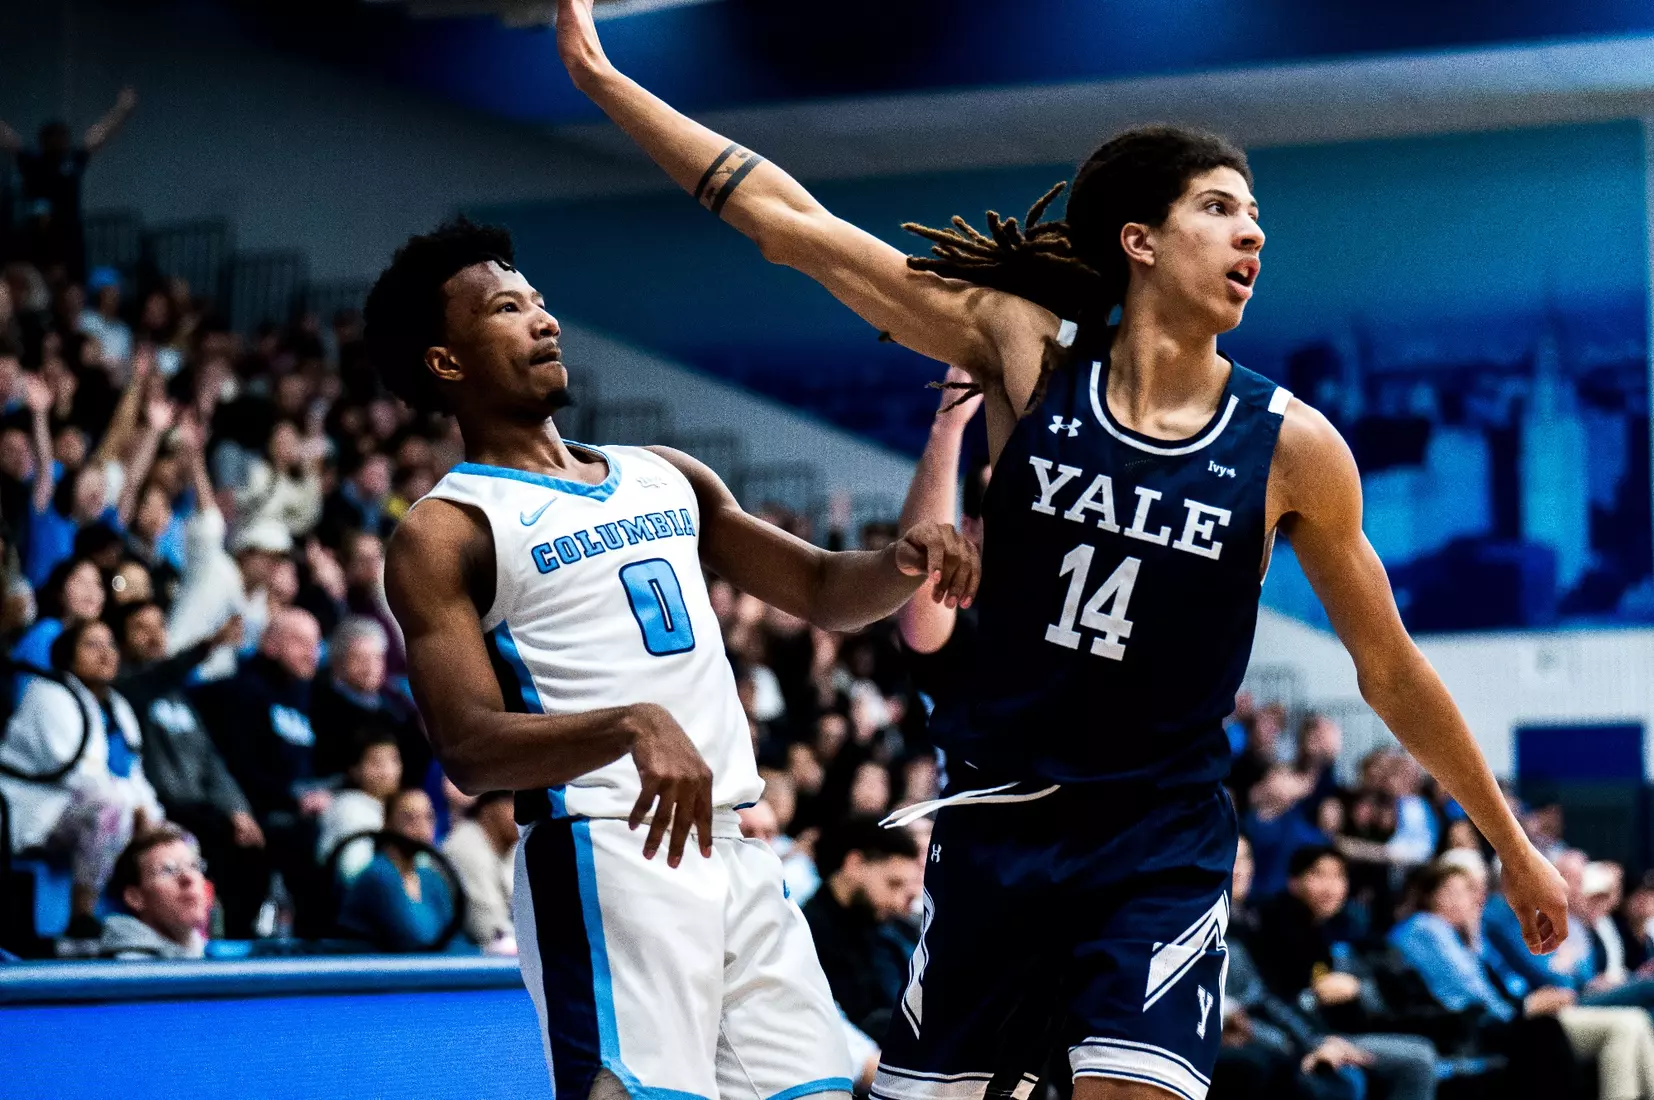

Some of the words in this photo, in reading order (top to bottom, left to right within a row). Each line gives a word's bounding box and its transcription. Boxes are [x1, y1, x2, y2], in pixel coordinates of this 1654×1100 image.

[1029, 455, 1232, 561] YALE
[1207, 460, 1227, 477] Ivy
[531, 508, 696, 575] COLUMBIA
[618, 557, 696, 657] 0
[1044, 543, 1142, 661] 14
[1196, 984, 1214, 1040] Y
